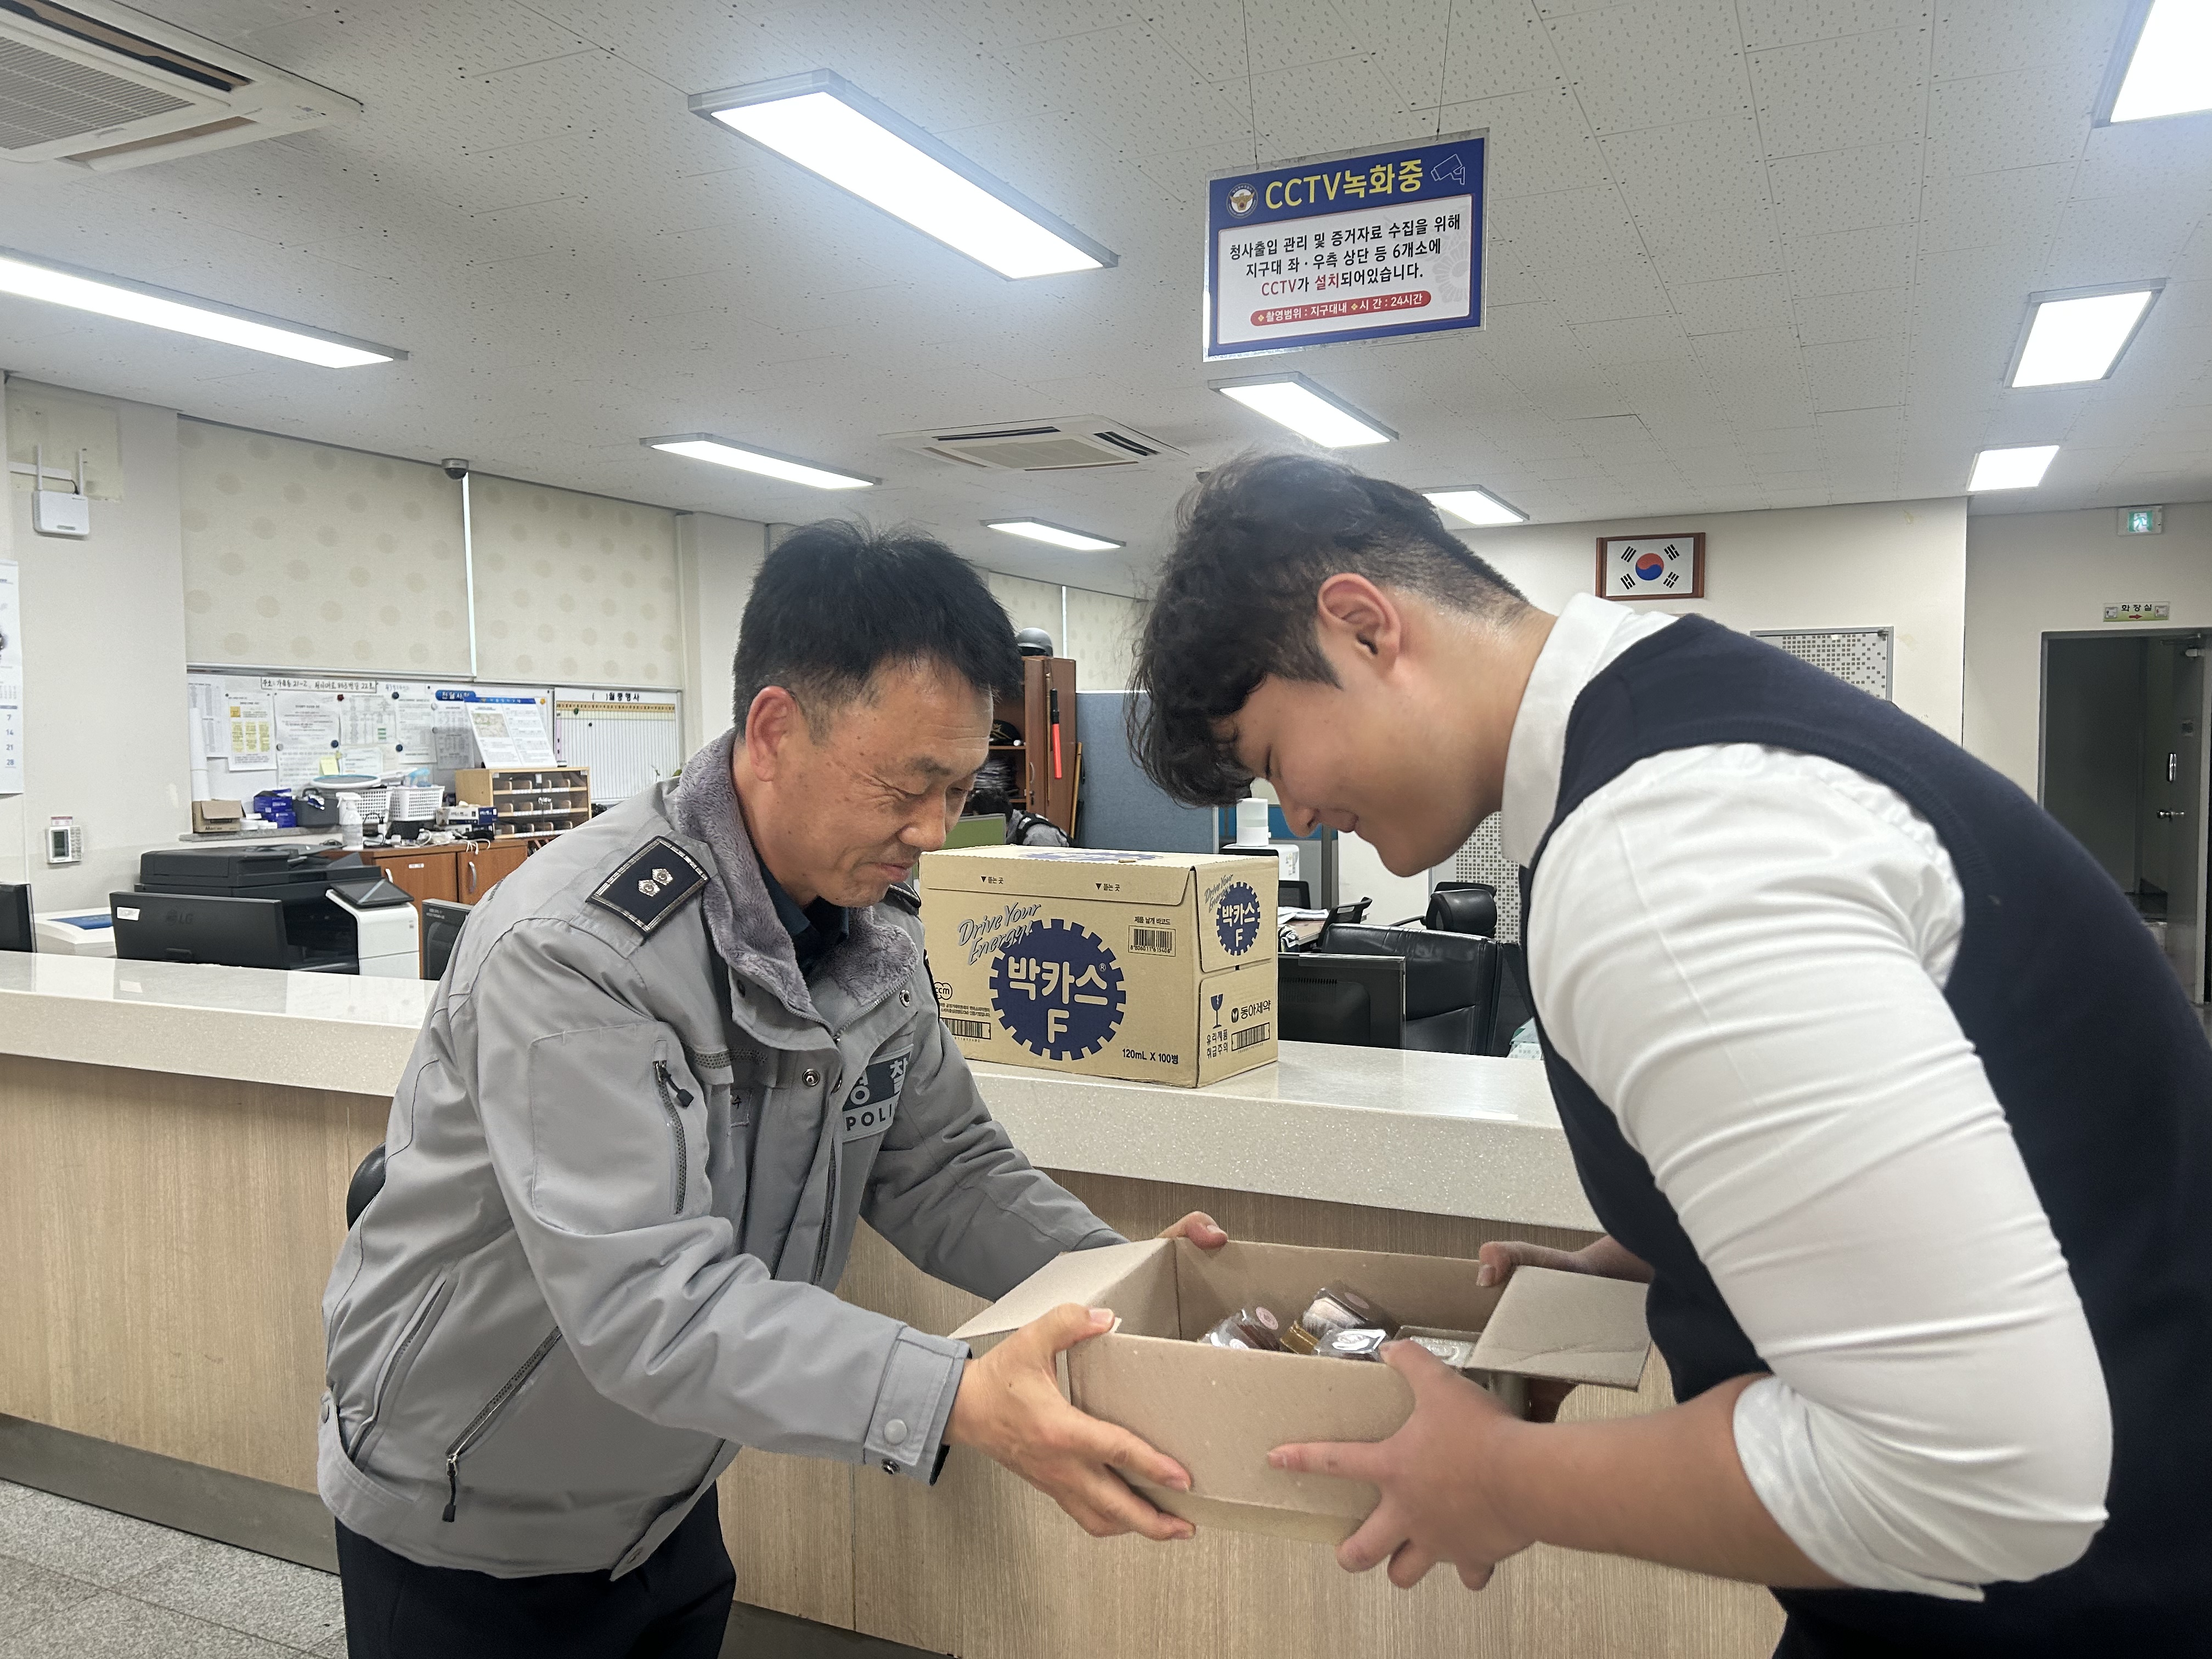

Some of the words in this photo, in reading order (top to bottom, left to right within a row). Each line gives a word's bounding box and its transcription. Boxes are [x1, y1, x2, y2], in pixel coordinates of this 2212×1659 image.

[1265, 159, 1423, 209] CCTV녹화중
[1230, 239, 1277, 260] 청사출입
[1284, 235, 1307, 252] 관리
[1314, 232, 1325, 249] 및
[1331, 225, 1383, 246] 증거자료
[1388, 218, 1427, 238] 수집을
[1434, 213, 1460, 232] 위해
[1246, 259, 1282, 278] 지구대
[1288, 257, 1300, 273] 좌
[1313, 252, 1338, 269] 우측
[1344, 248, 1369, 266] 상단
[1374, 246, 1387, 262] 등
[1393, 238, 1441, 258] 6개소에
[1261, 277, 1309, 296] CCTV가
[1314, 263, 1423, 291] 설치되어있습니다.
[1266, 308, 1301, 322] 촬영범위
[1311, 302, 1347, 317] 지구대내
[1390, 294, 1423, 307] 24시간
[179, 913, 193, 924] LG
[957, 915, 1003, 946] Drive
[1004, 902, 1042, 927] Your
[1222, 902, 1255, 927] 박카스
[968, 920, 1034, 966] Energy!
[1235, 928, 1243, 947] F
[1008, 956, 1108, 1006] 박카스
[1240, 1000, 1271, 1019] 동아제약
[1048, 1008, 1069, 1043] F
[1206, 1029, 1228, 1046] 유리제품
[1122, 1048, 1147, 1060] 120mL
[1158, 1053, 1178, 1064] 100병
[1206, 1042, 1228, 1059] 취급주의
